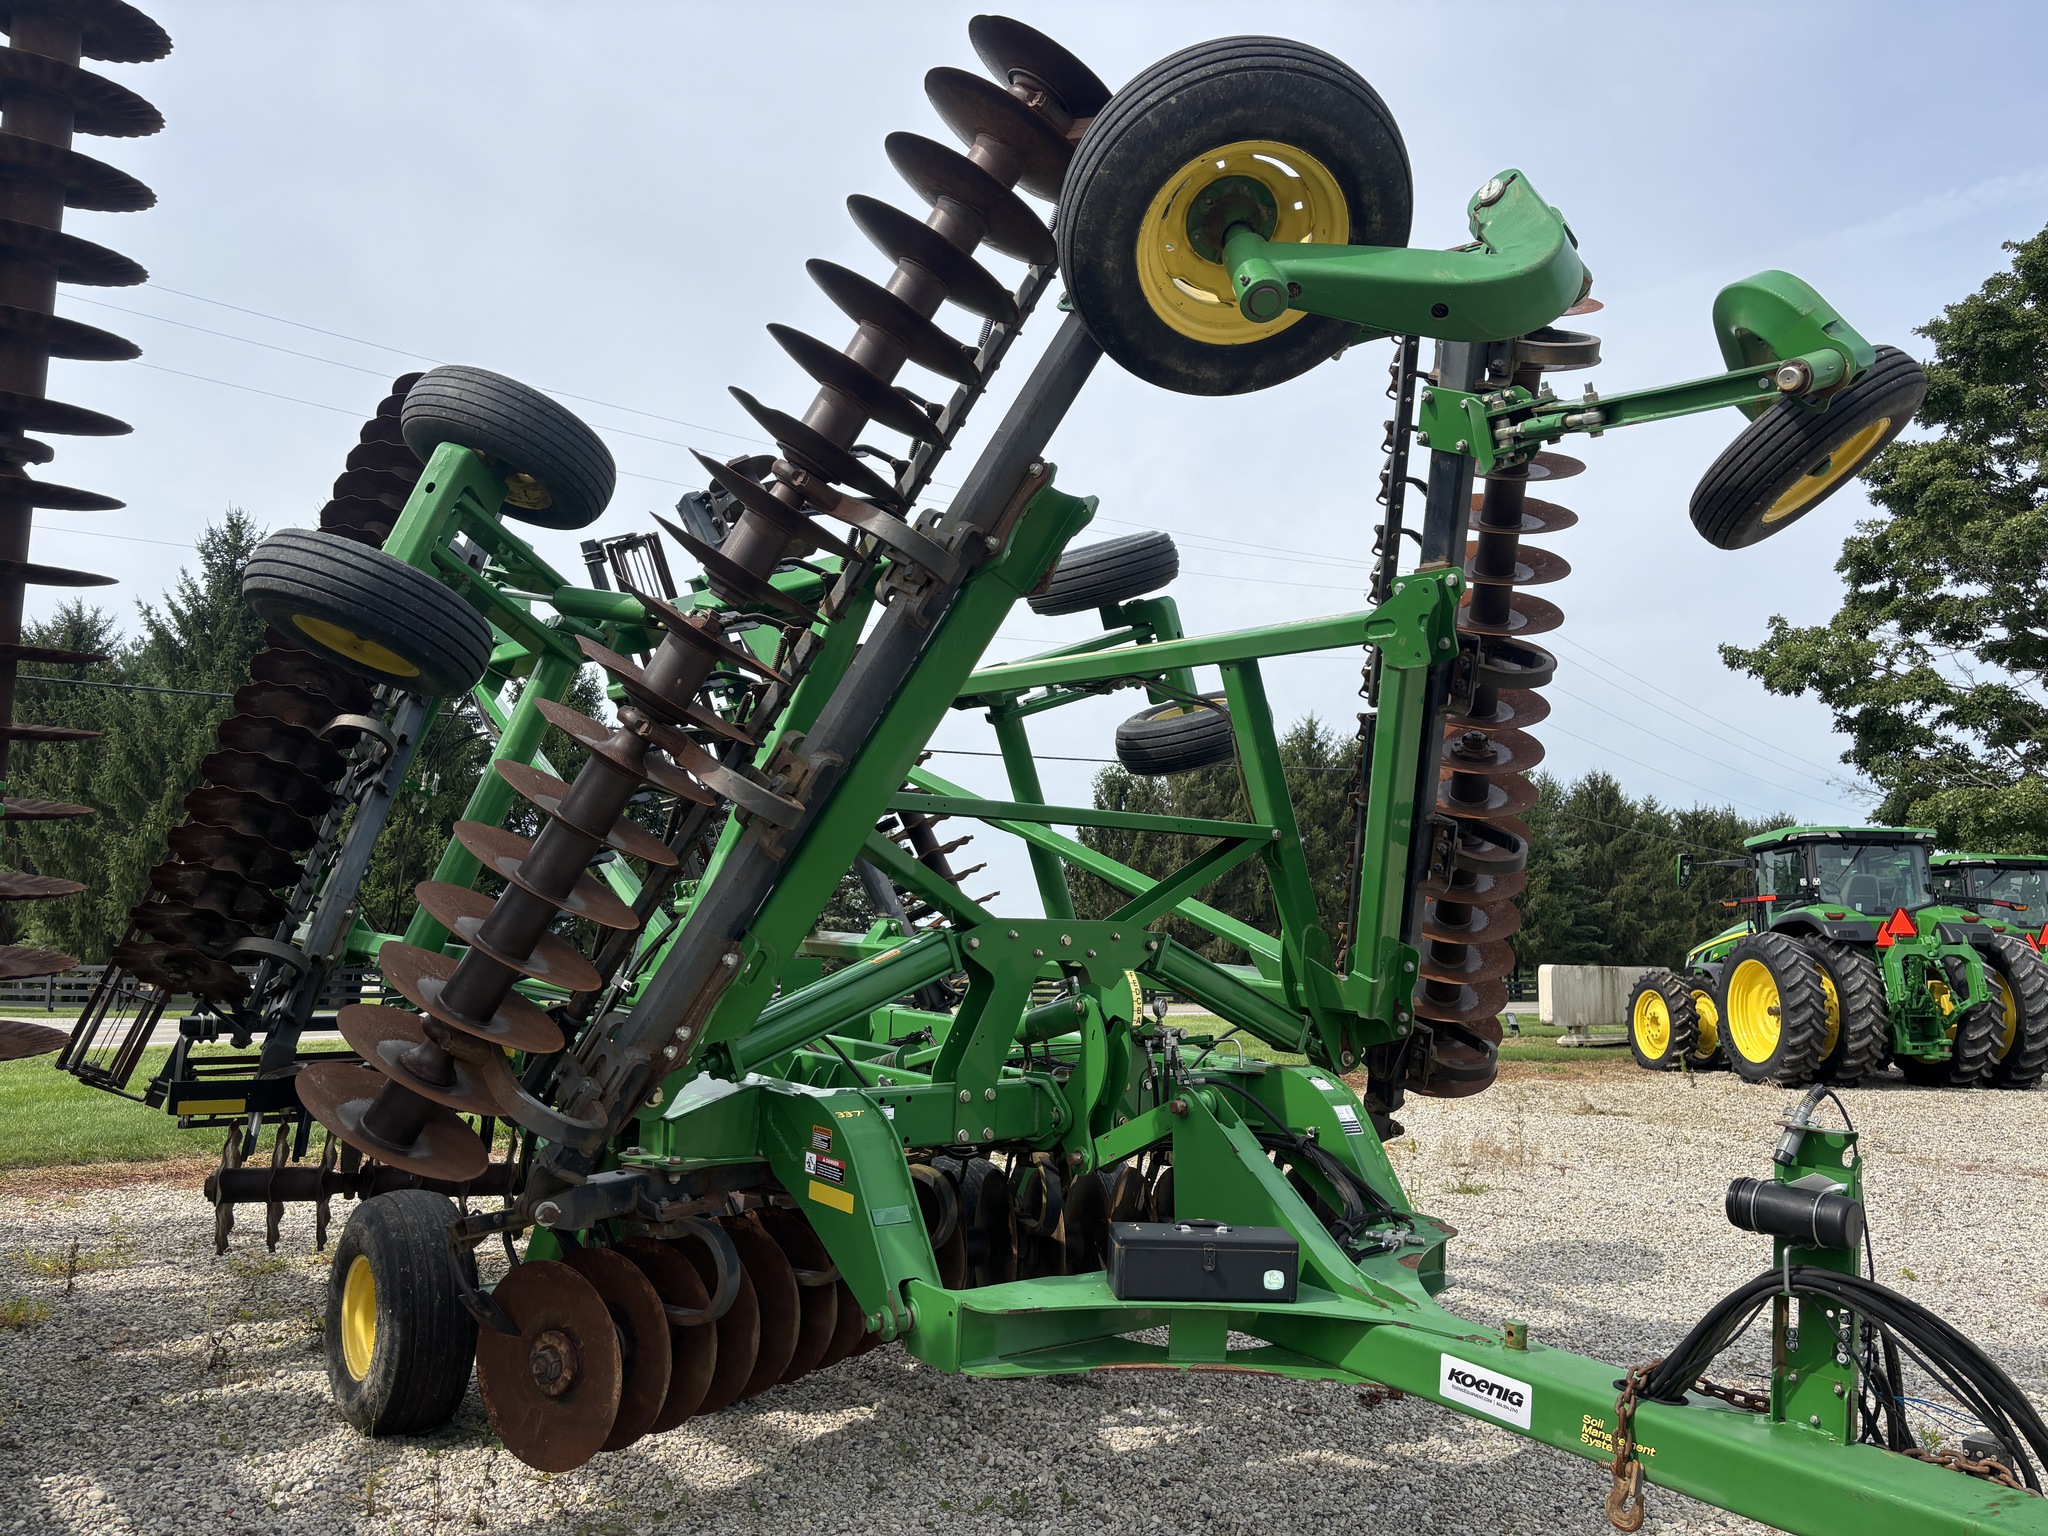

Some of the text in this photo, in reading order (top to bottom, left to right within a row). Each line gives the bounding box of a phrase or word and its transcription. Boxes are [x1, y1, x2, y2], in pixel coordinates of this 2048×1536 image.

[1135, 988, 1140, 996] D
[1136, 997, 1142, 1005] C
[1136, 1006, 1142, 1015] B
[1135, 1016, 1141, 1025] A
[1582, 1414, 1605, 1429] Soil
[1580, 1433, 1624, 1455] Syste
[1581, 1424, 1657, 1457] Manaeent
